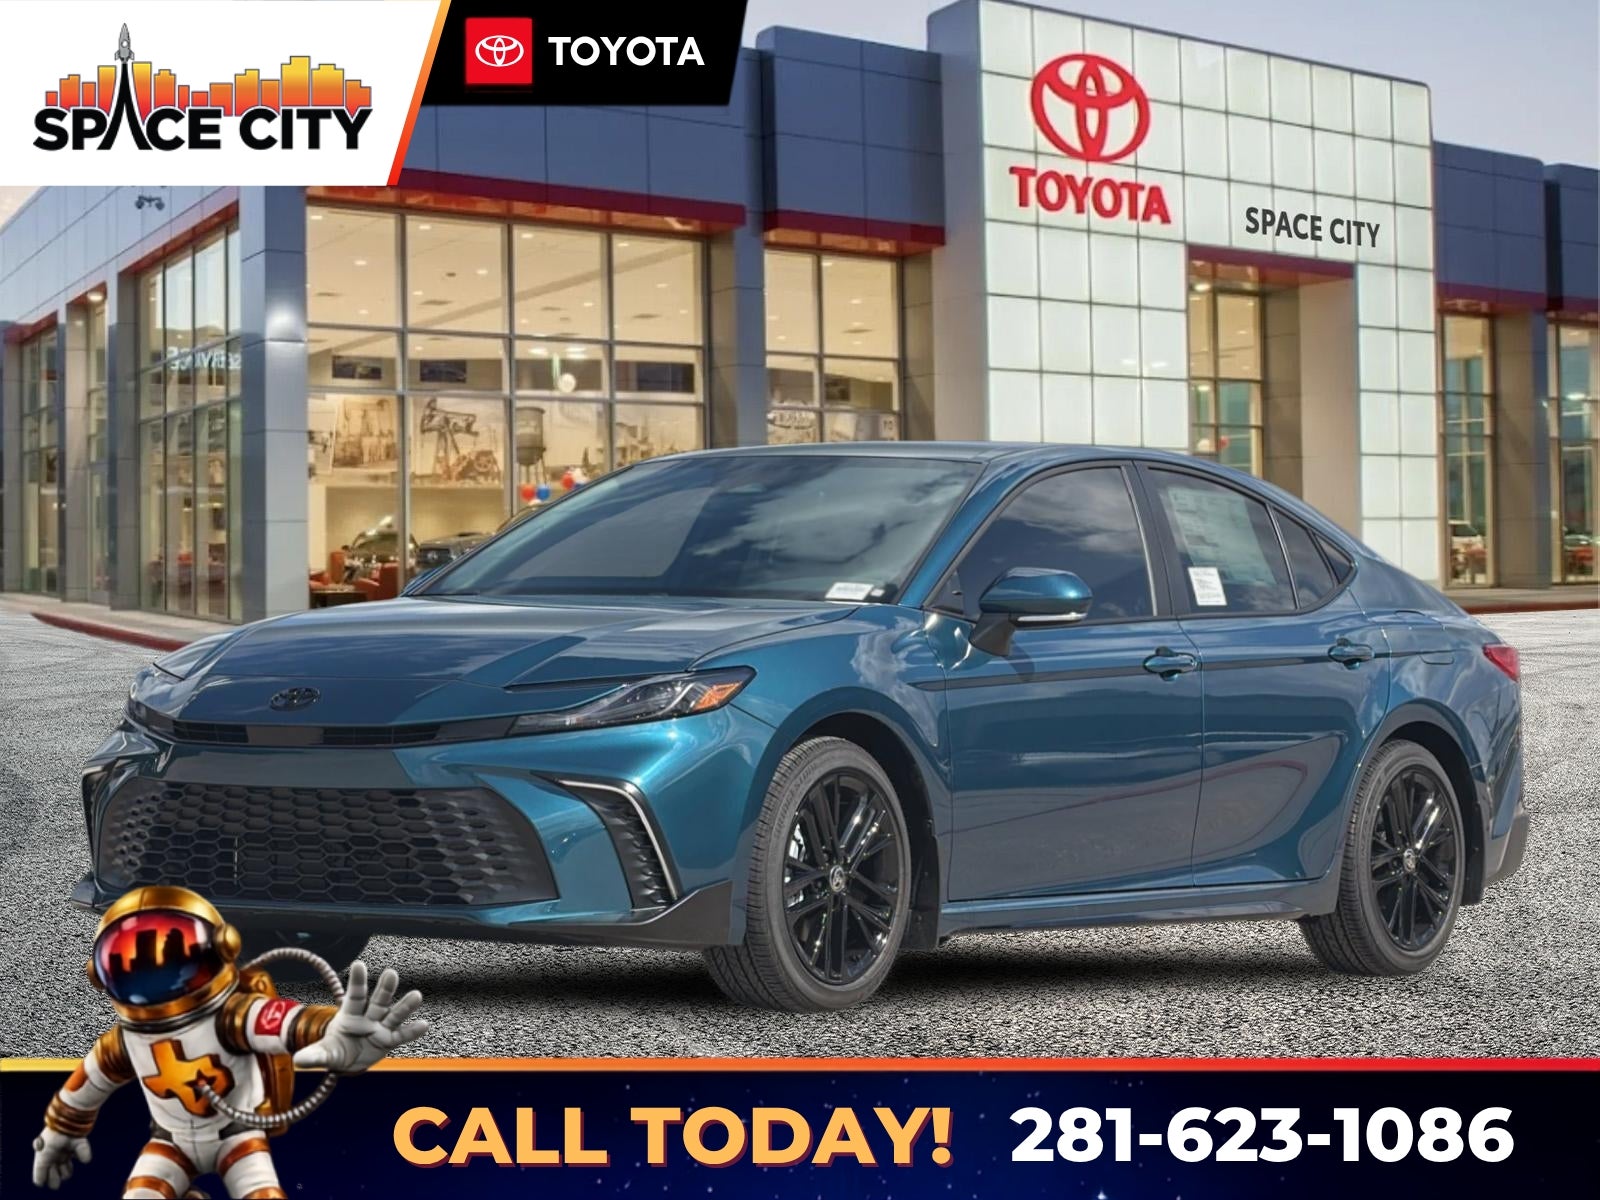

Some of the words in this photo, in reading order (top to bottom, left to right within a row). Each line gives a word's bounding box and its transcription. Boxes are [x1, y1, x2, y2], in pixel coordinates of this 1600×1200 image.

[1008, 166, 1171, 224] TOYOTA
[1245, 206, 1323, 242] SPACE
[1329, 217, 1381, 248] CITY
